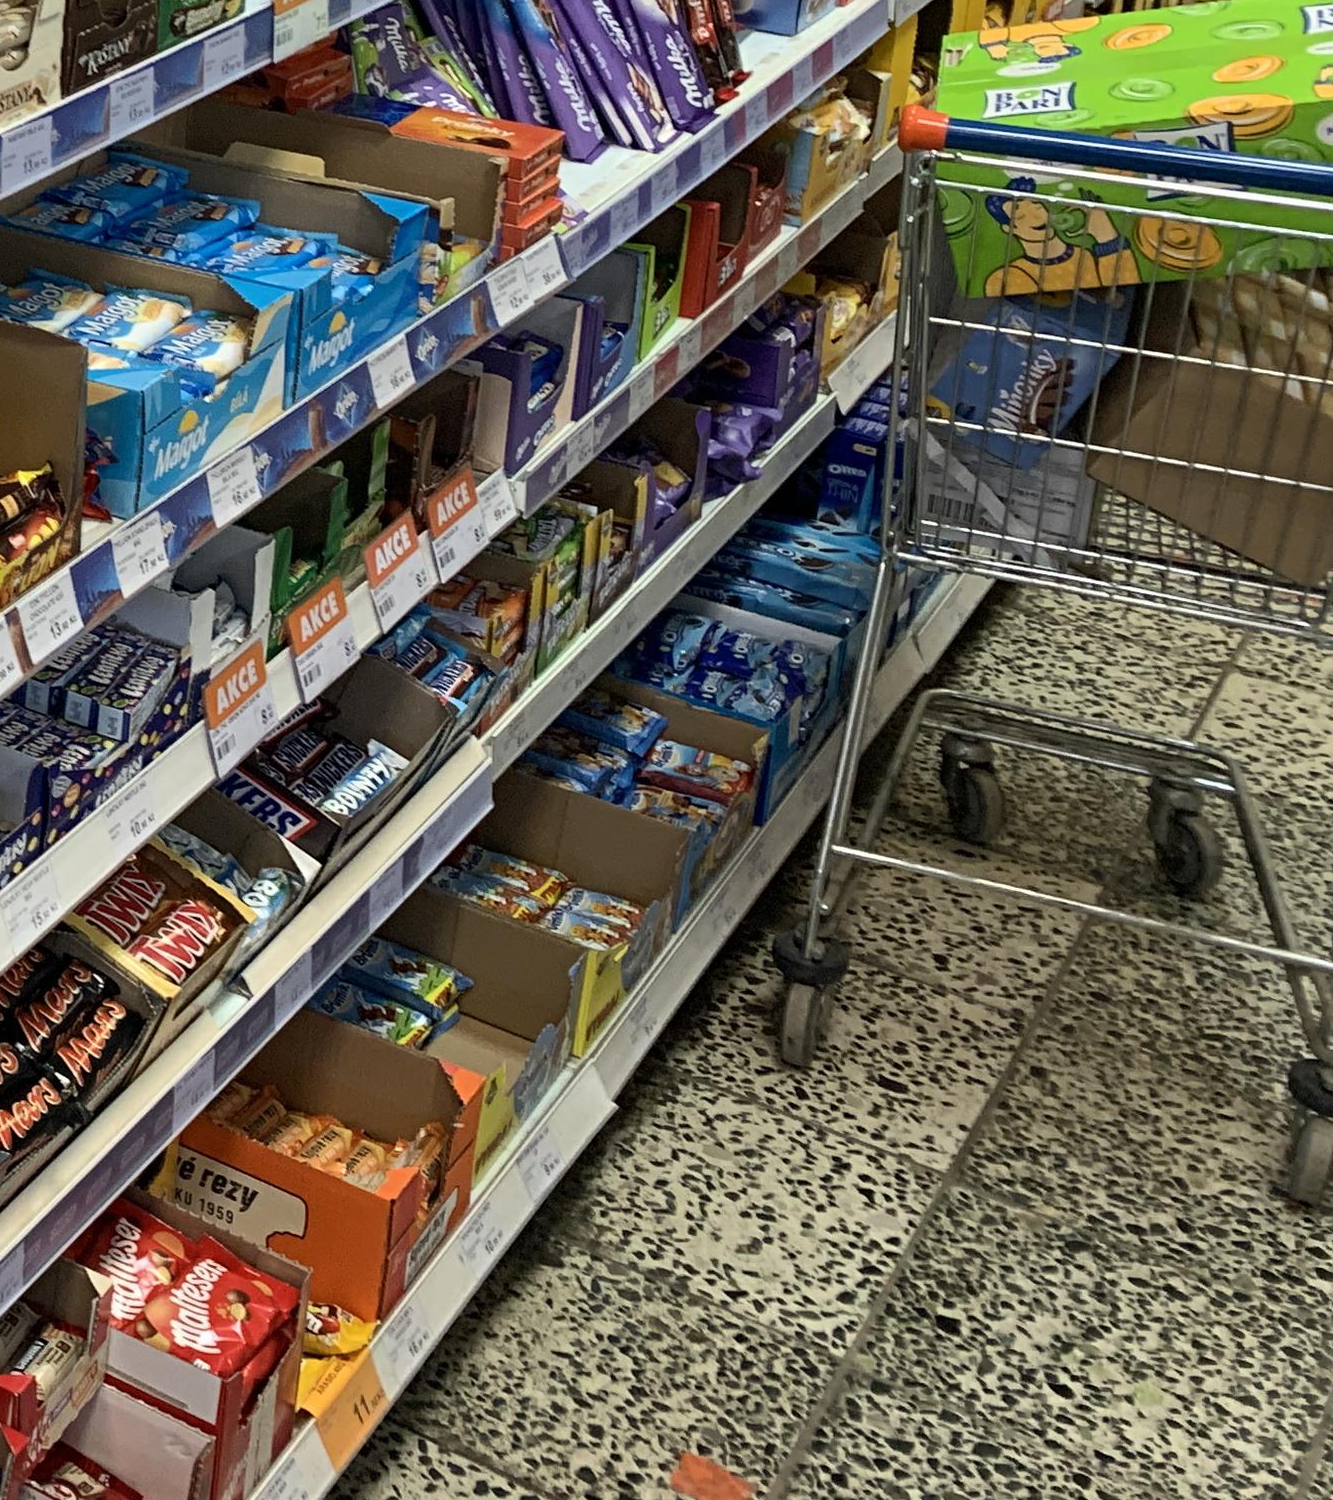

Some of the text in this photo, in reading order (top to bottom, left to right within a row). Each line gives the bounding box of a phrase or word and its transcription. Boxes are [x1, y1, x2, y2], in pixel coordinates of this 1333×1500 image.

[304, 326, 356, 378] Margot
[153, 425, 213, 483] Margot
[436, 482, 472, 529] AKCE
[373, 529, 413, 573] AKCE
[298, 596, 342, 643] AKCE
[213, 659, 259, 713] AKCE
[132, 898, 227, 987] TWIX
[15, 956, 95, 1052] Mars
[57, 999, 127, 1087] Mars
[175, 1255, 229, 1351] Maltesers
